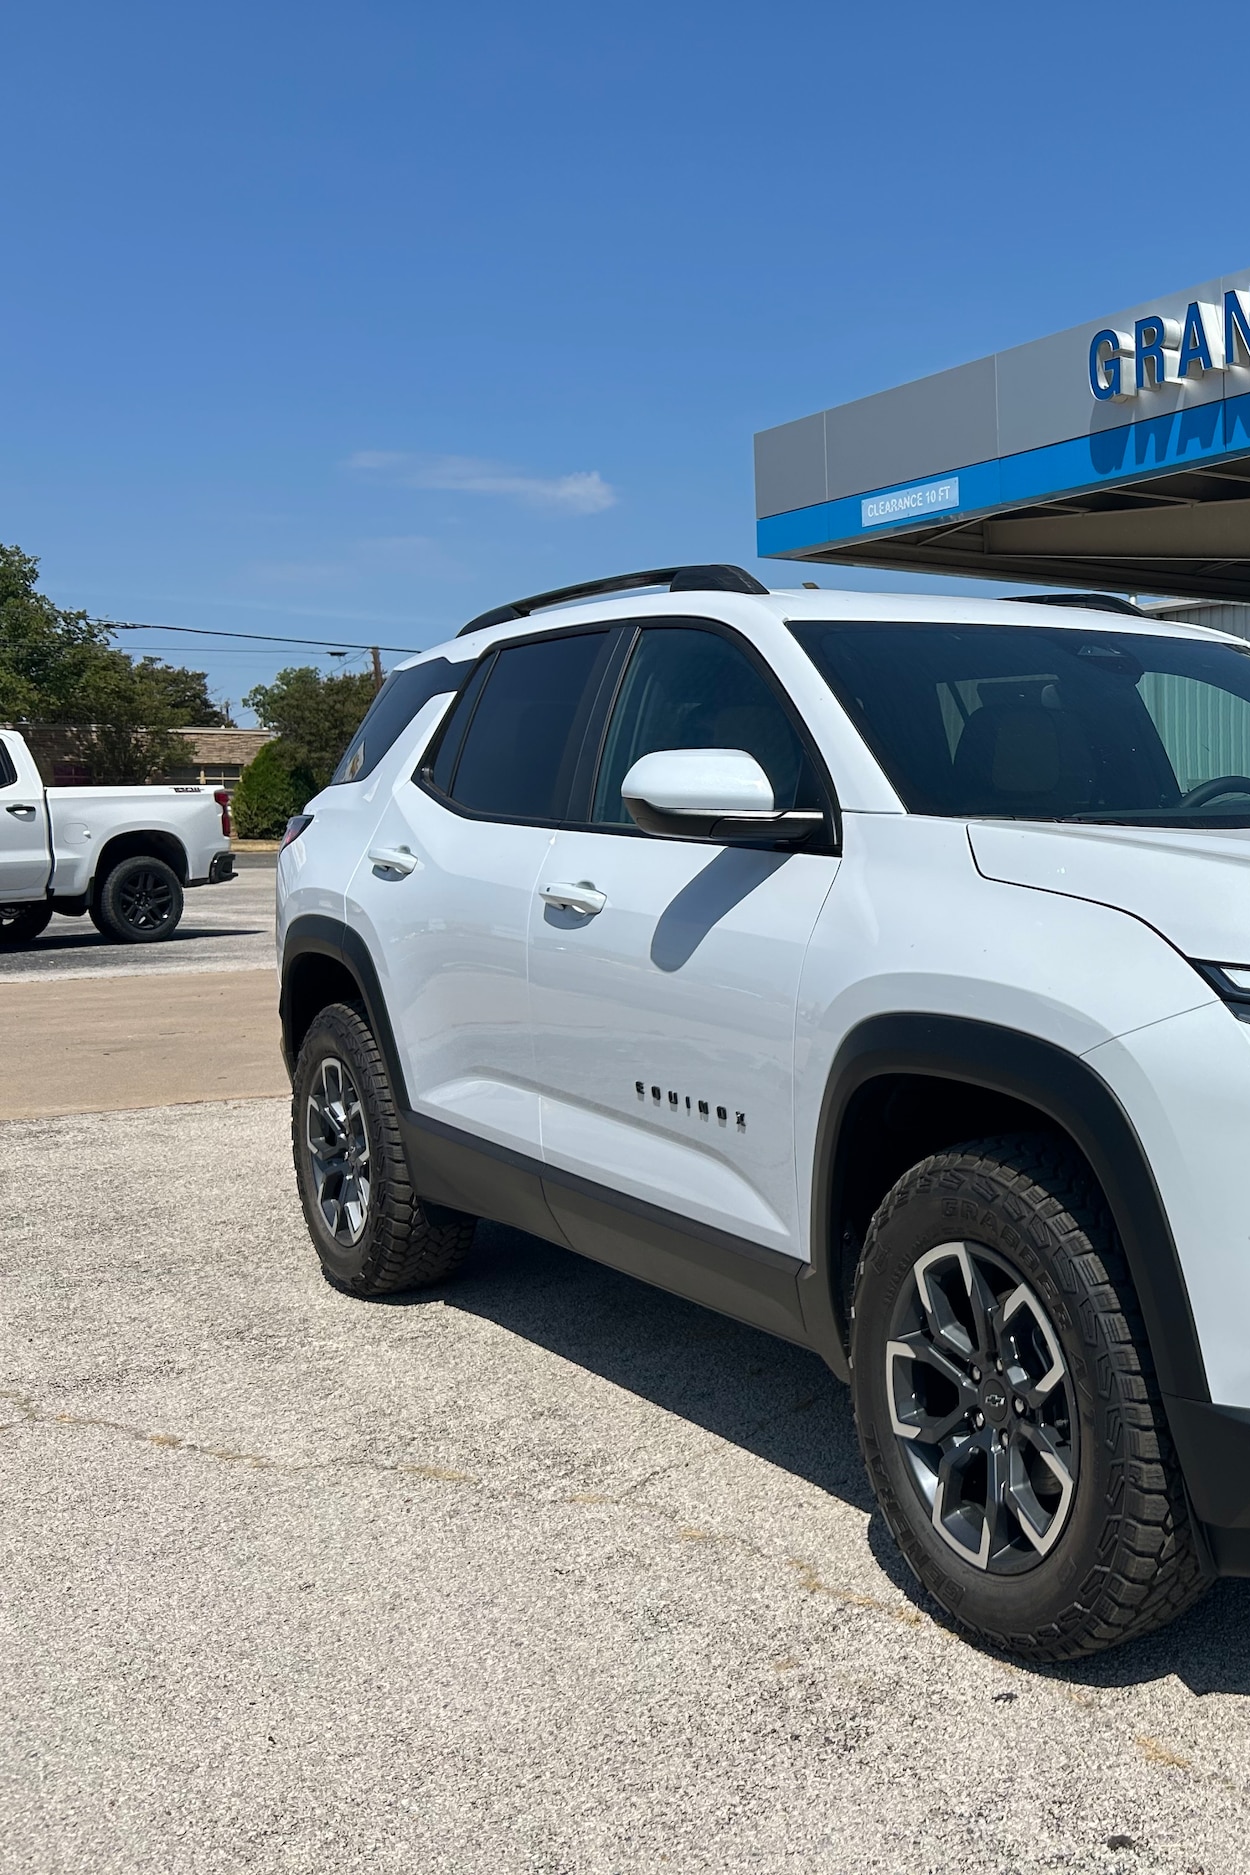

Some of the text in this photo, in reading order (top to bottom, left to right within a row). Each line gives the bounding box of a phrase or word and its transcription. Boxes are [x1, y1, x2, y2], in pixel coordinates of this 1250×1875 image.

[867, 486, 951, 518] CLEARANCE 10 FT
[635, 1080, 747, 1127] EQUINOX
[940, 1196, 1073, 1331] GRABBER
